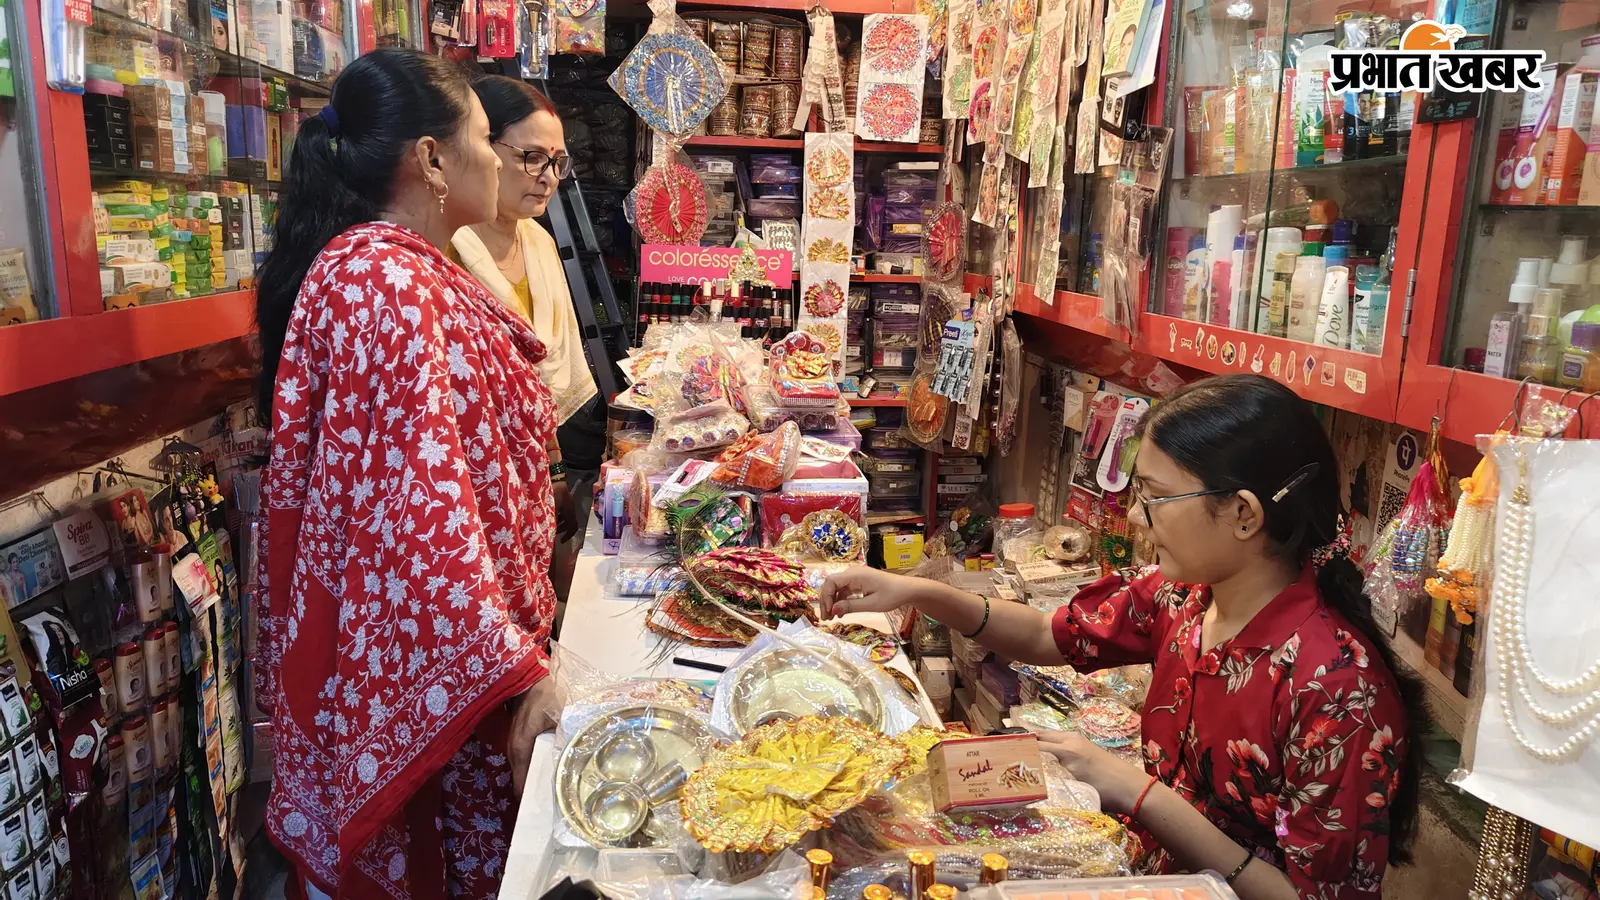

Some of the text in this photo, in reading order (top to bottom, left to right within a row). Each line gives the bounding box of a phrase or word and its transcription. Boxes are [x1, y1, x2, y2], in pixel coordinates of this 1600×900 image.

[71, 8, 88, 22] FREE
[649, 248, 781, 270] coloréssece
[1322, 304, 1344, 347] Dove
[67, 520, 94, 544] Spinz
[79, 533, 91, 546] BB
[60, 670, 88, 691] Nisha
[959, 759, 993, 782] Sandal
